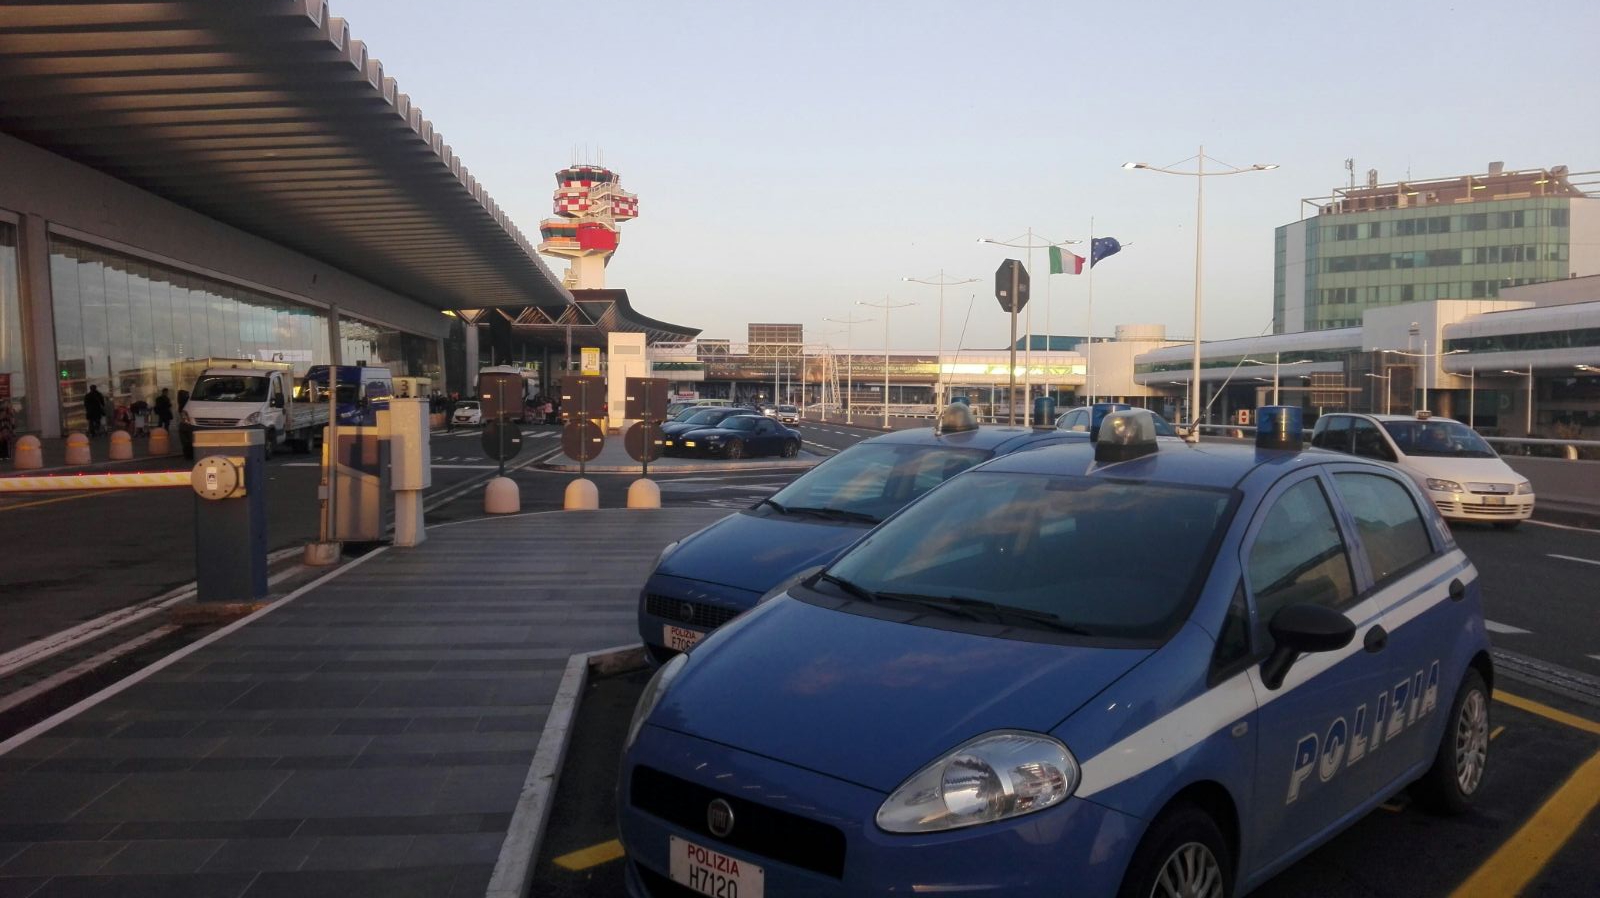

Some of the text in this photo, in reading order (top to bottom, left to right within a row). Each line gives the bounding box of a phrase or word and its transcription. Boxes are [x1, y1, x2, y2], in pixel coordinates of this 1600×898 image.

[400, 380, 408, 391] 3
[671, 626, 697, 639] POLIZIA
[1286, 659, 1439, 805] POLIZIA
[712, 809, 729, 828] FIAT
[688, 843, 740, 878] POLIZIA
[689, 863, 738, 898] H7120
